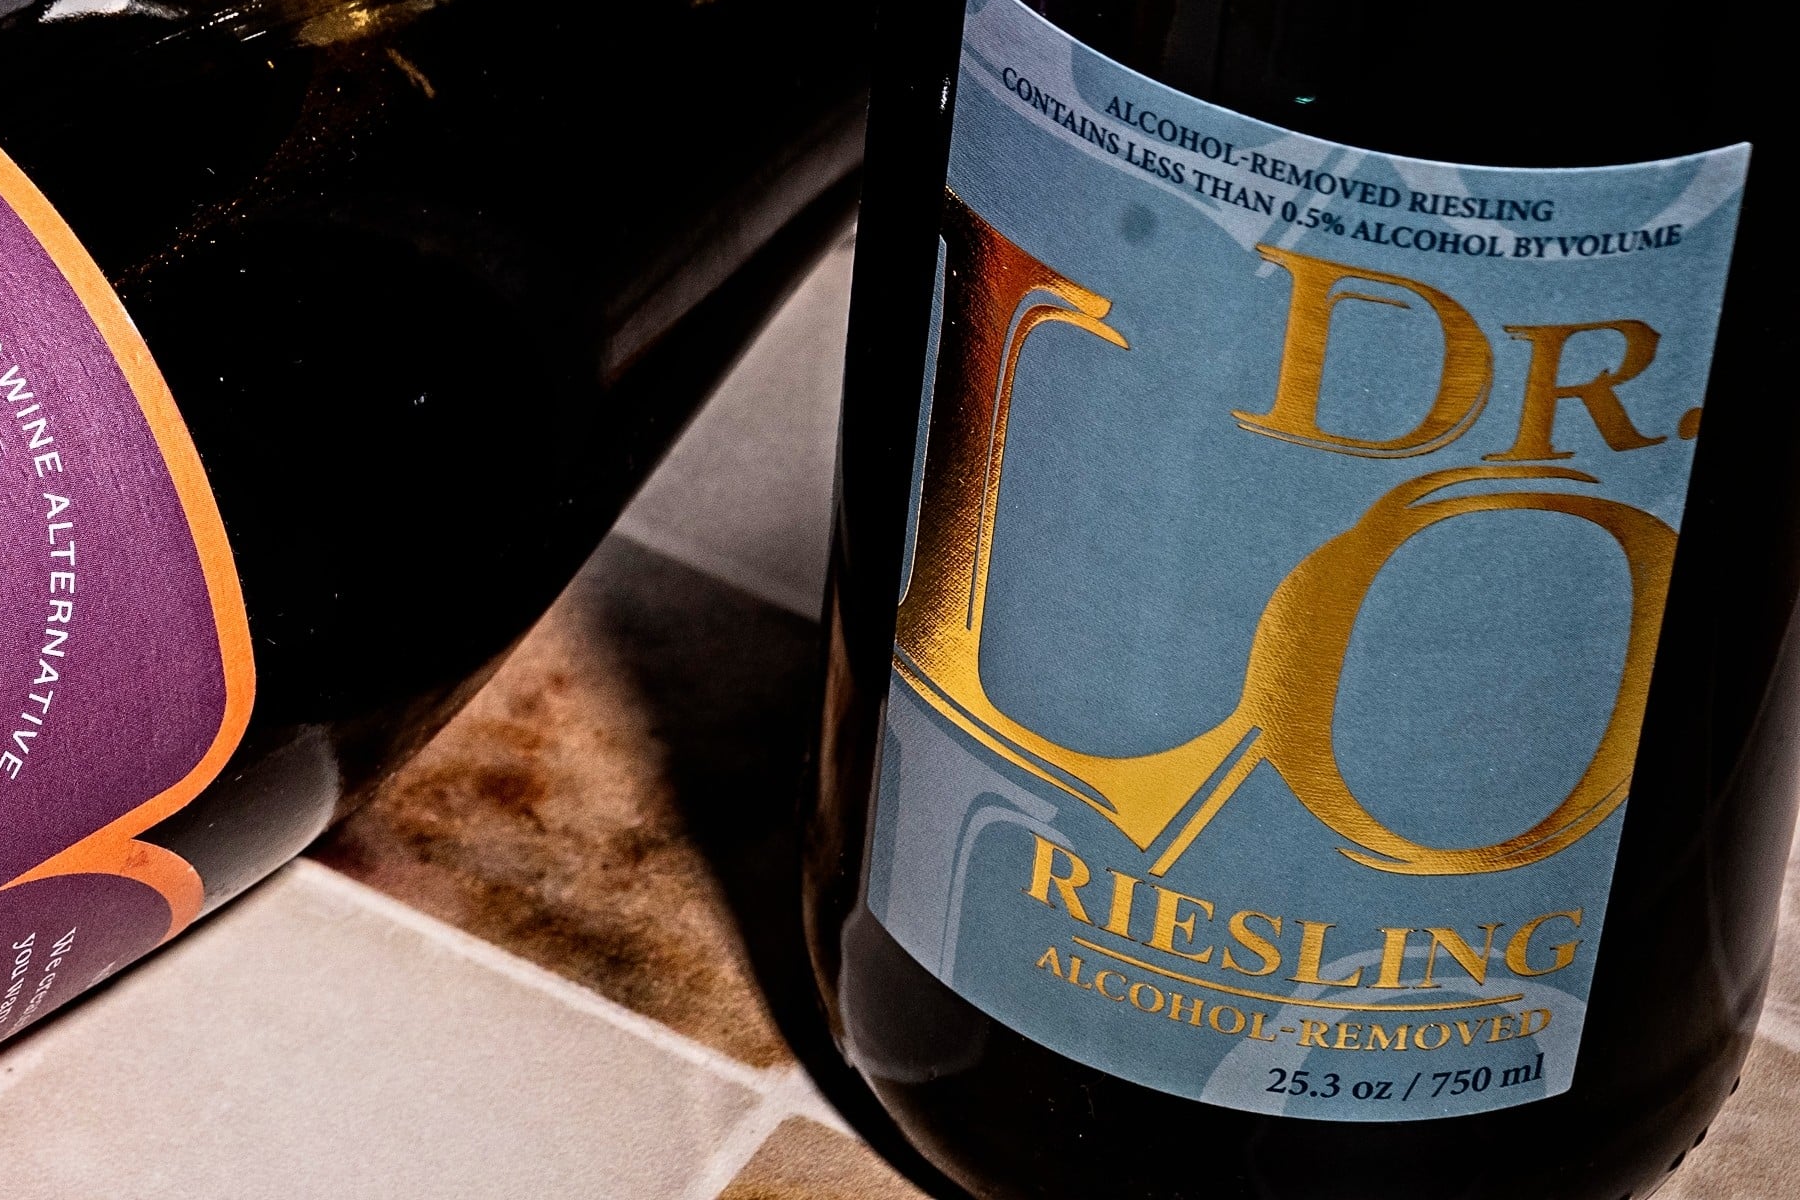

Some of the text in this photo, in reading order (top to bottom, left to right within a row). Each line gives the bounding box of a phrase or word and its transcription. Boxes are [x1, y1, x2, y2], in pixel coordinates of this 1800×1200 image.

[1000, 66, 1684, 260] CONTAINS LESS THAN 0.5% ALCOHOL BY VOLUME
[1104, 95, 1555, 224] ALCOHOL-REMOVED RIESLING
[1230, 243, 1702, 462] DR.
[11, 932, 37, 980] you
[45, 927, 77, 971] We
[1021, 830, 1586, 990] RIESLING
[1035, 945, 1554, 1052] ALCOHOL-REMOVED
[1264, 1066, 1342, 1100] 25.3
[1352, 1075, 1394, 1102] oz
[1429, 1065, 1493, 1099] 750
[1499, 1052, 1545, 1091] ml
